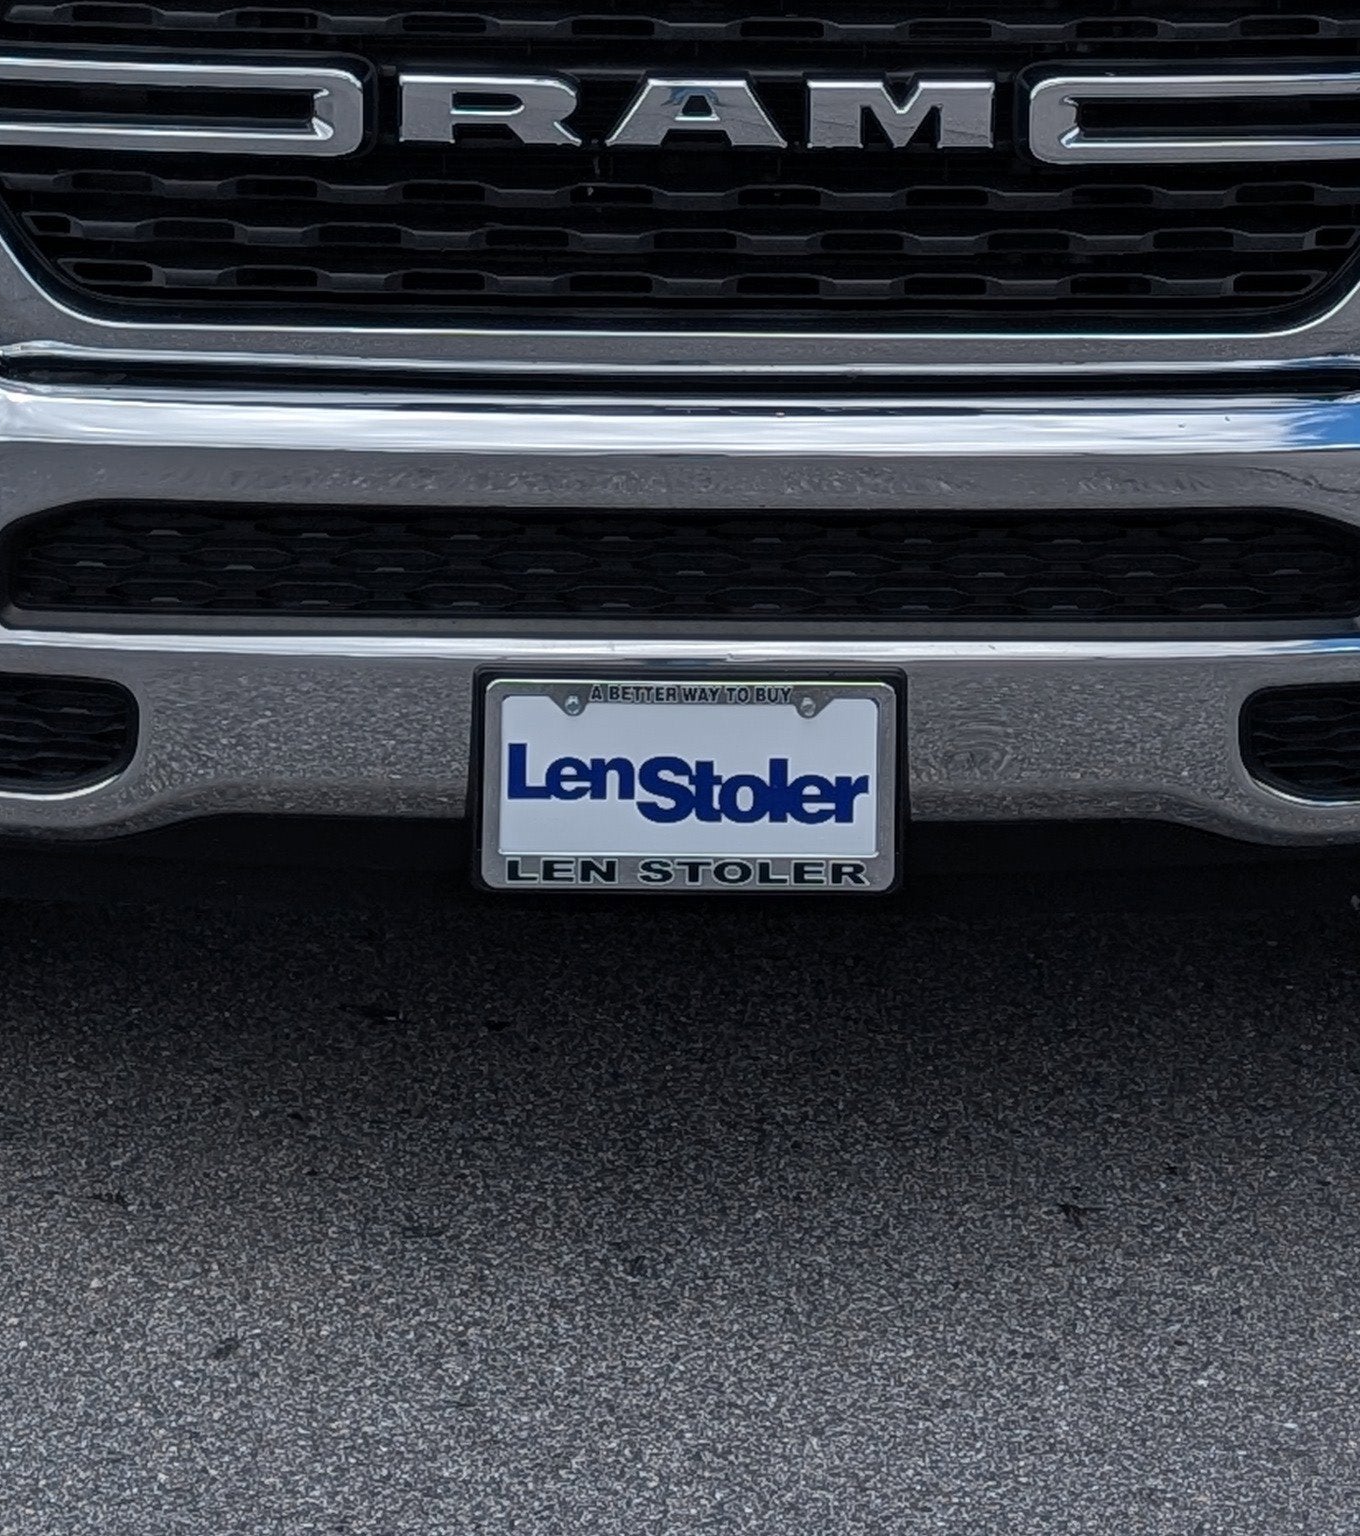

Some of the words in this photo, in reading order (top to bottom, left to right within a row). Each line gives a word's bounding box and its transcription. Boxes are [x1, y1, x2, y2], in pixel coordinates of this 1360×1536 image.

[399, 73, 995, 148] RAM
[591, 684, 603, 703] A
[608, 685, 677, 703] BETTER
[681, 685, 720, 703] WAY
[725, 685, 749, 703] TO
[755, 685, 794, 704] BUY
[506, 858, 618, 884] LEN
[638, 858, 871, 886] STOLER
